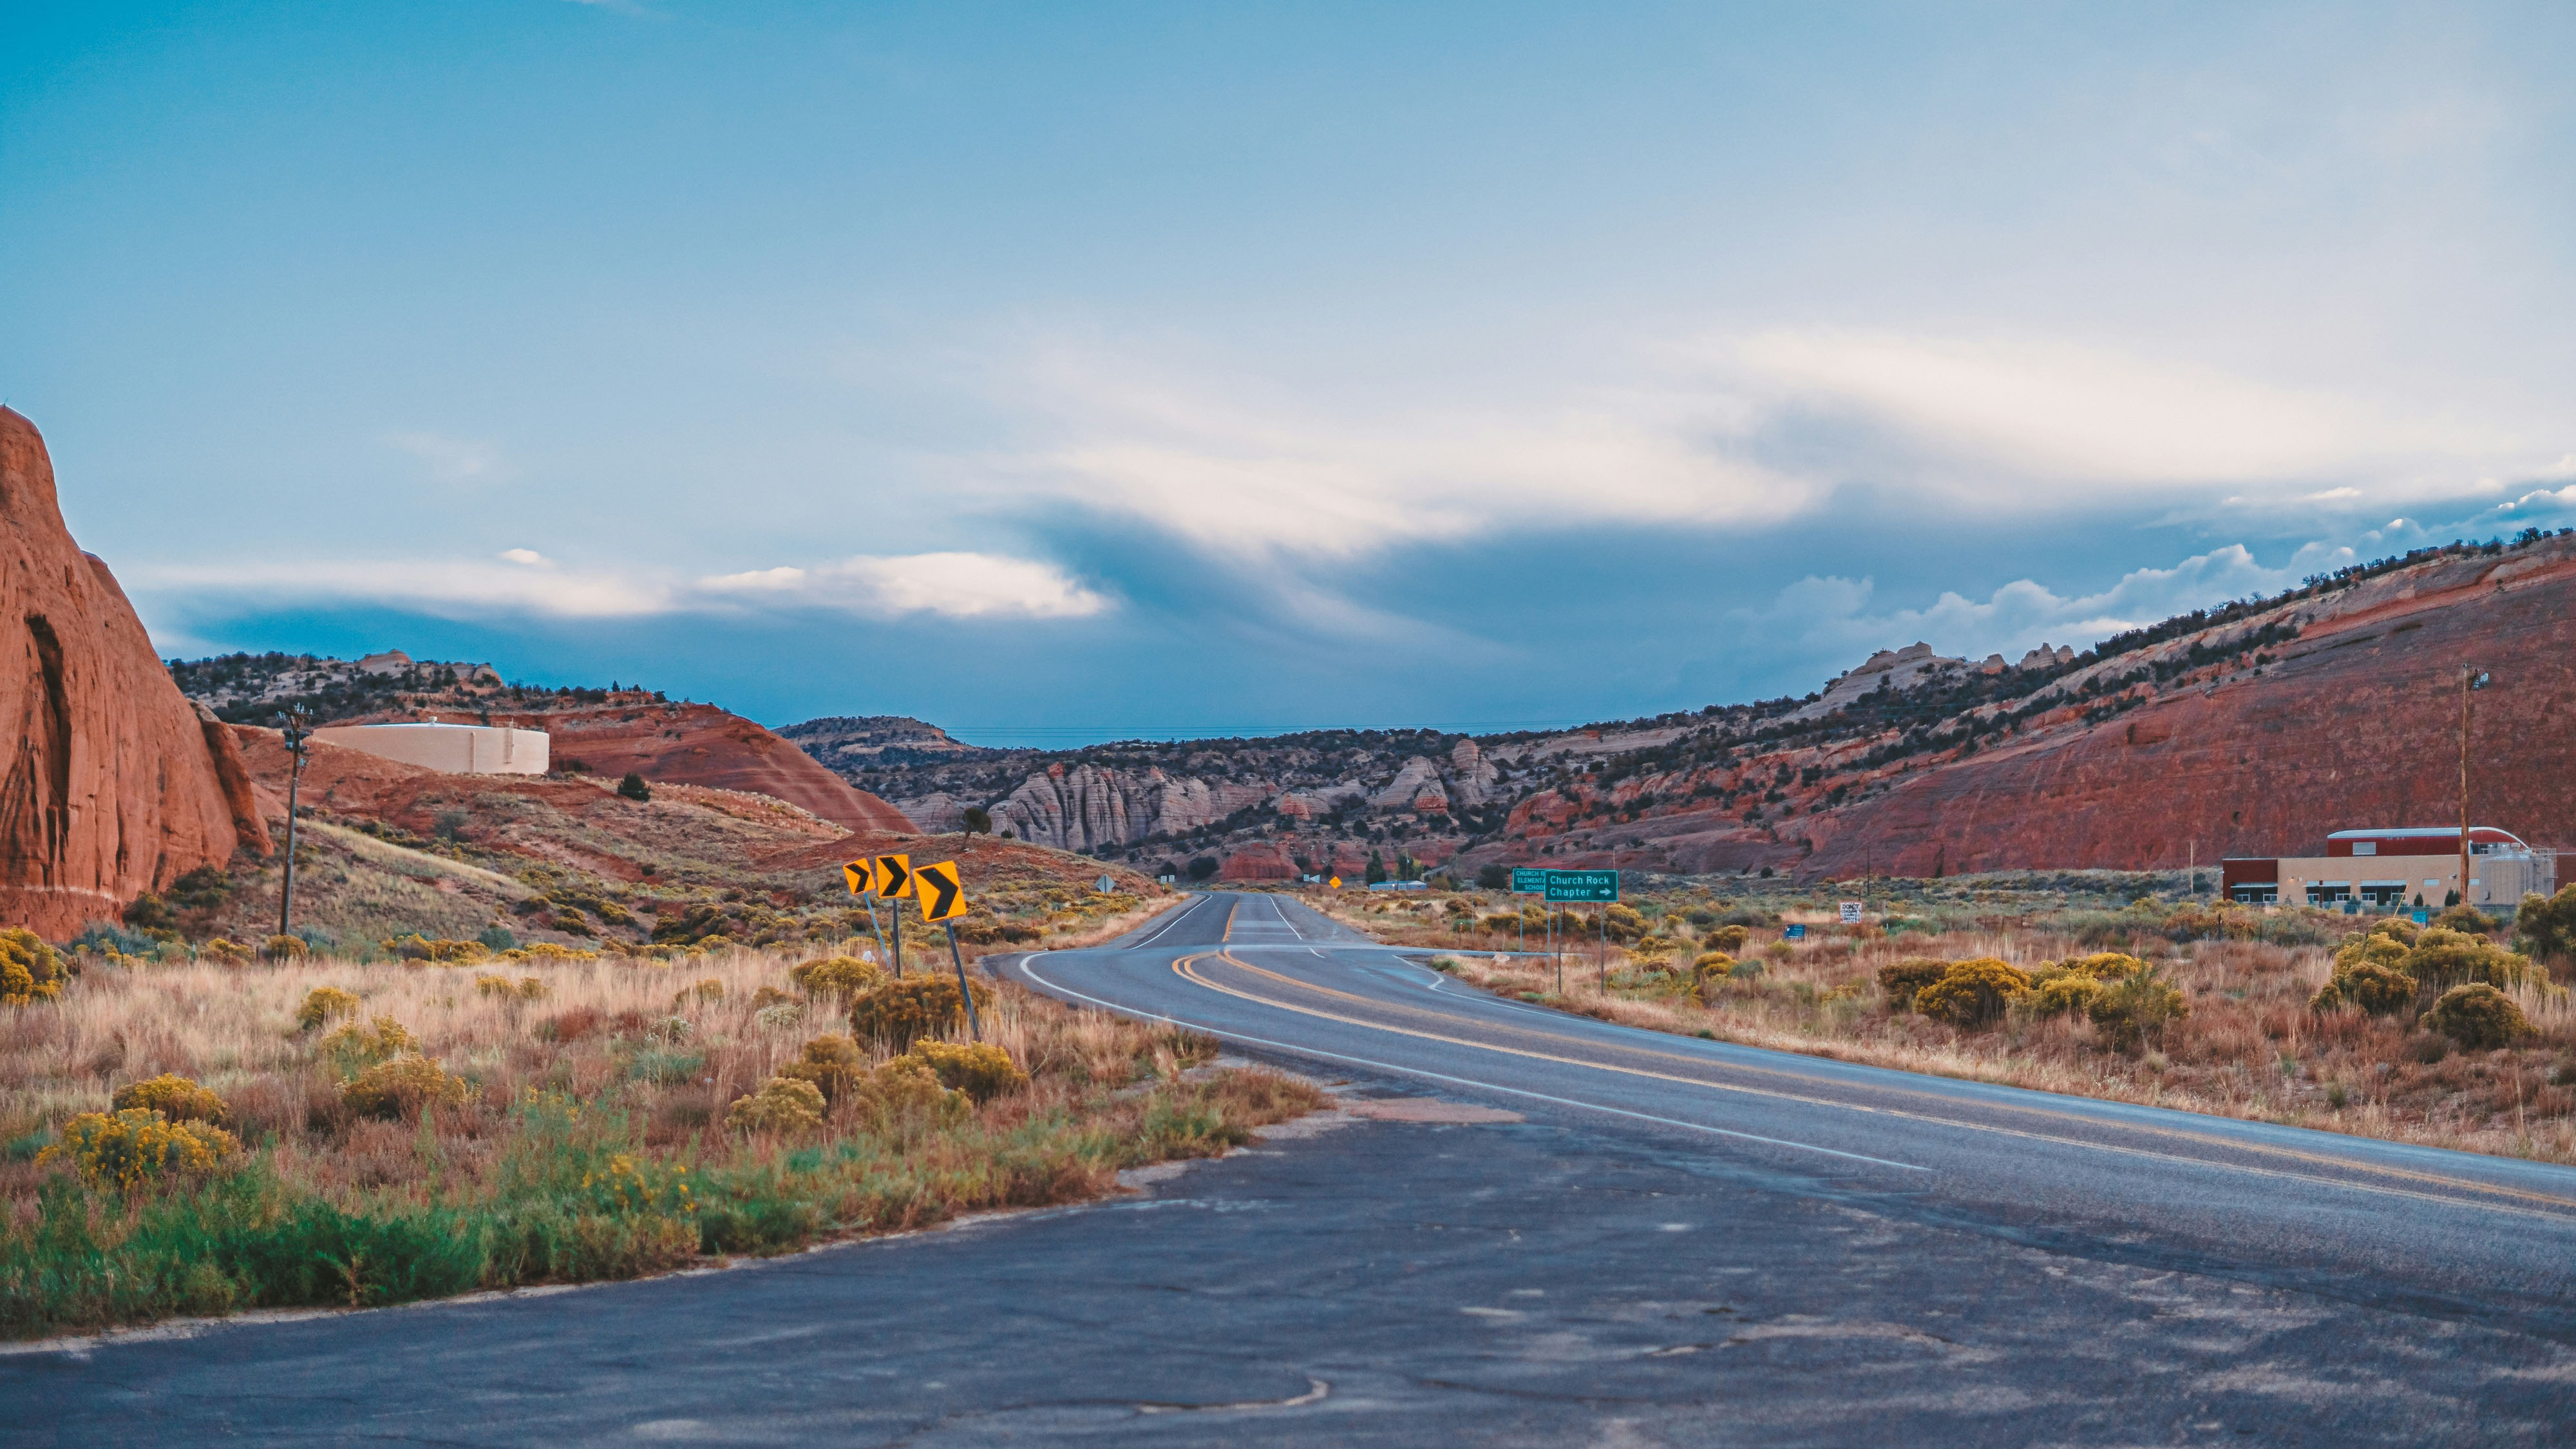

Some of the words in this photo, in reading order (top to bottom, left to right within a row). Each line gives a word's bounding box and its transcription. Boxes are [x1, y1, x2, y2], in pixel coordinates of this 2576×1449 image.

[1550, 876, 1583, 884] Church
[1586, 876, 1609, 884] Rock
[1550, 887, 1591, 898] Chapter
